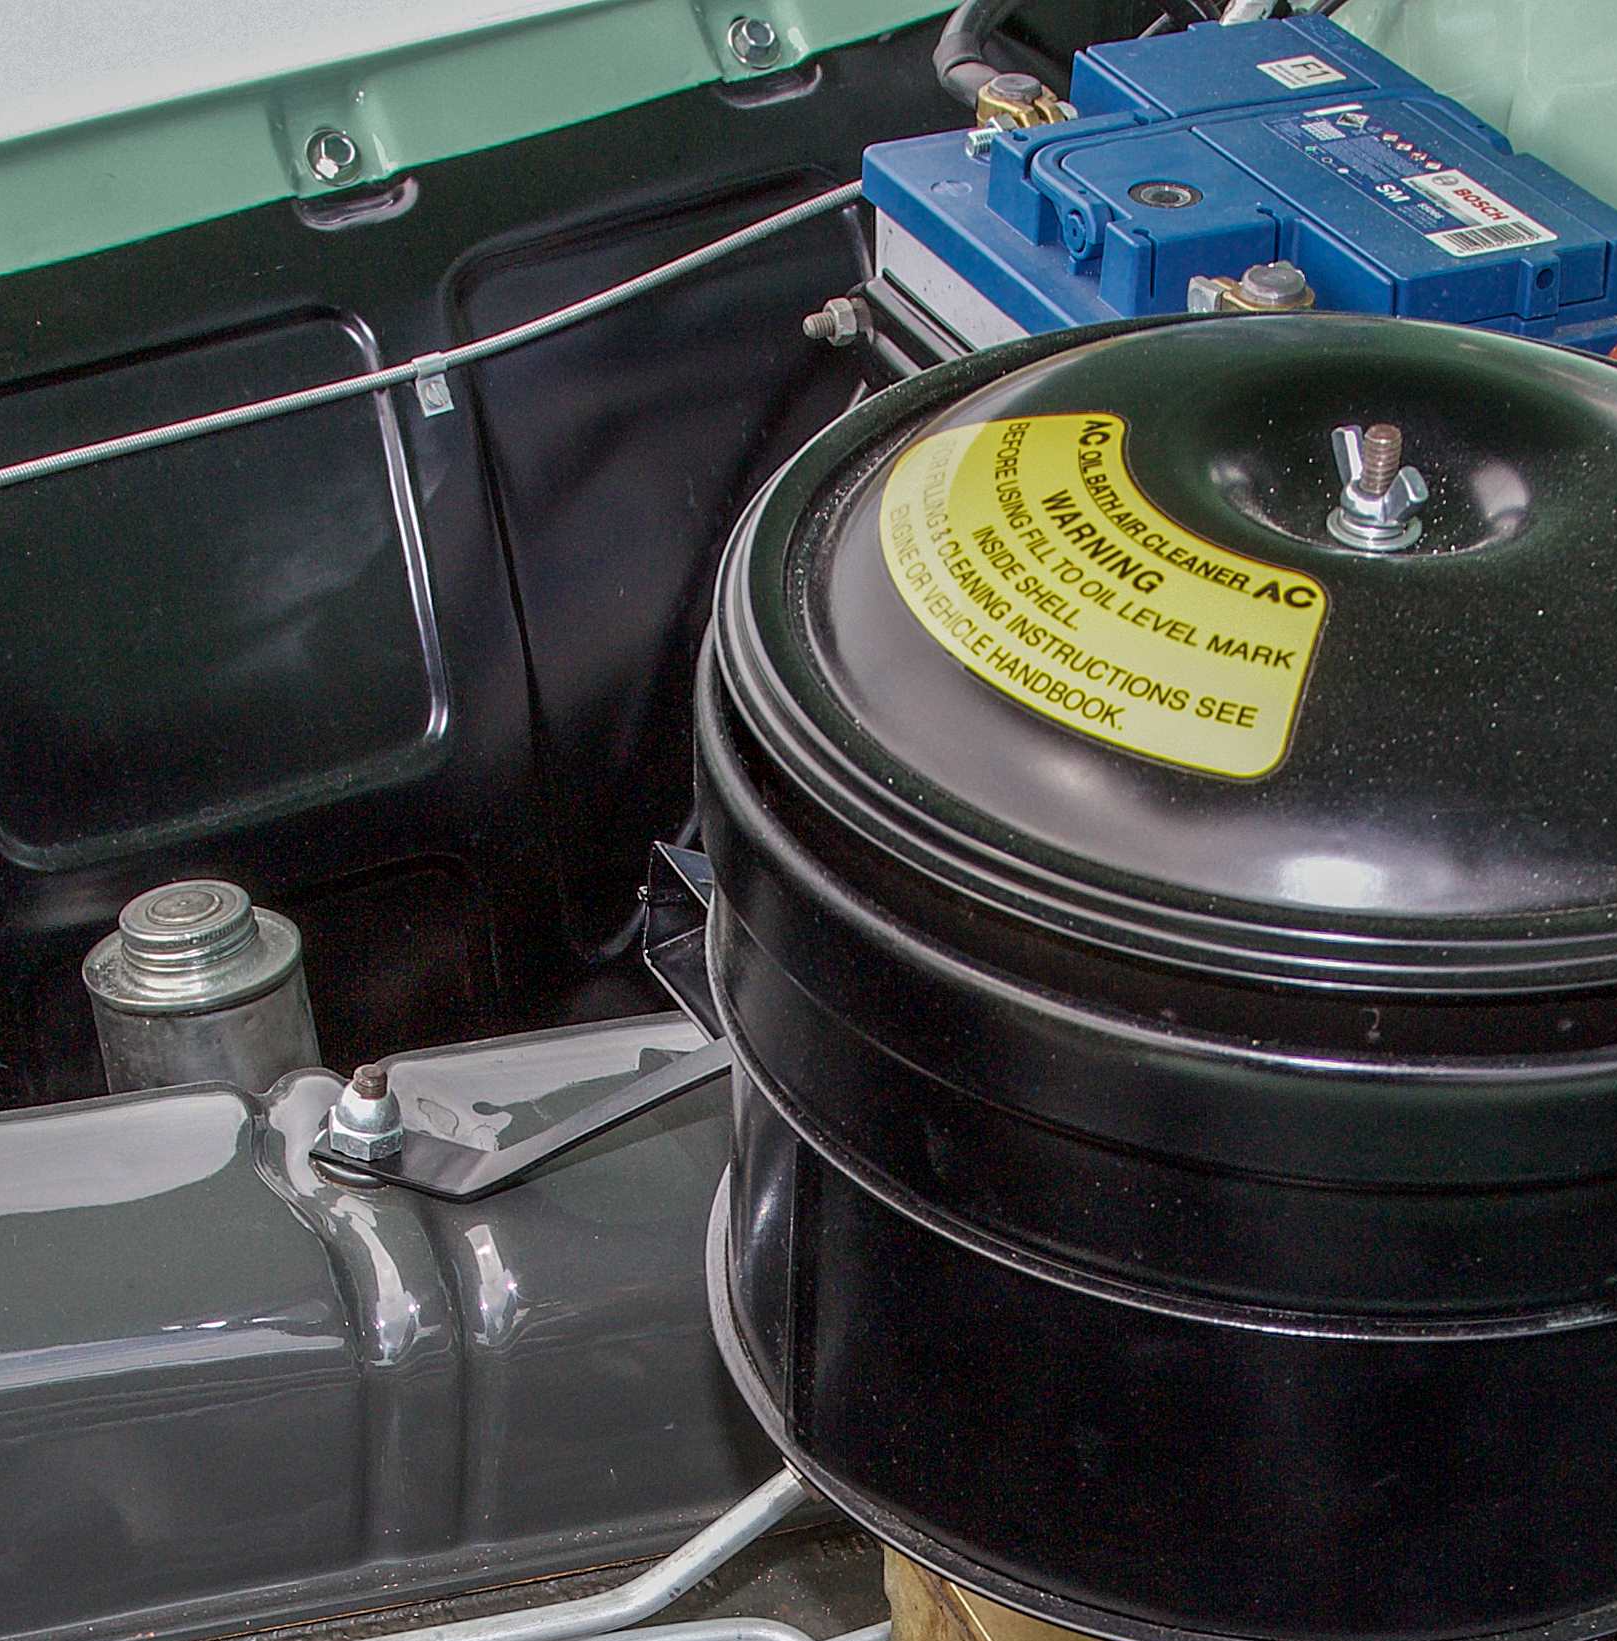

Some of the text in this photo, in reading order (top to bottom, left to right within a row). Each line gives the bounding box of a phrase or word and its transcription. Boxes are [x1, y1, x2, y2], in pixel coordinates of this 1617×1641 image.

[1291, 61, 1333, 78] F1
[1375, 182, 1411, 202] SM
[1453, 188, 1509, 221] BOSCH
[923, 471, 950, 530] FILLING
[1041, 488, 1164, 594] WARNING
[1079, 420, 1317, 609] AC OIL BATH AIR CLEANER AC
[936, 540, 1012, 622] CLEANING
[971, 525, 1081, 631] INSIDE SHELL.
[994, 422, 1297, 670] BEFORE USING FILL TO OIL LEVEL MARK
[890, 503, 1126, 732] ENGINE OR VEHICLE HANDBOOK.
[1005, 613, 1191, 711] INSTRUCTIONS
[1195, 696, 1259, 729] SEE
